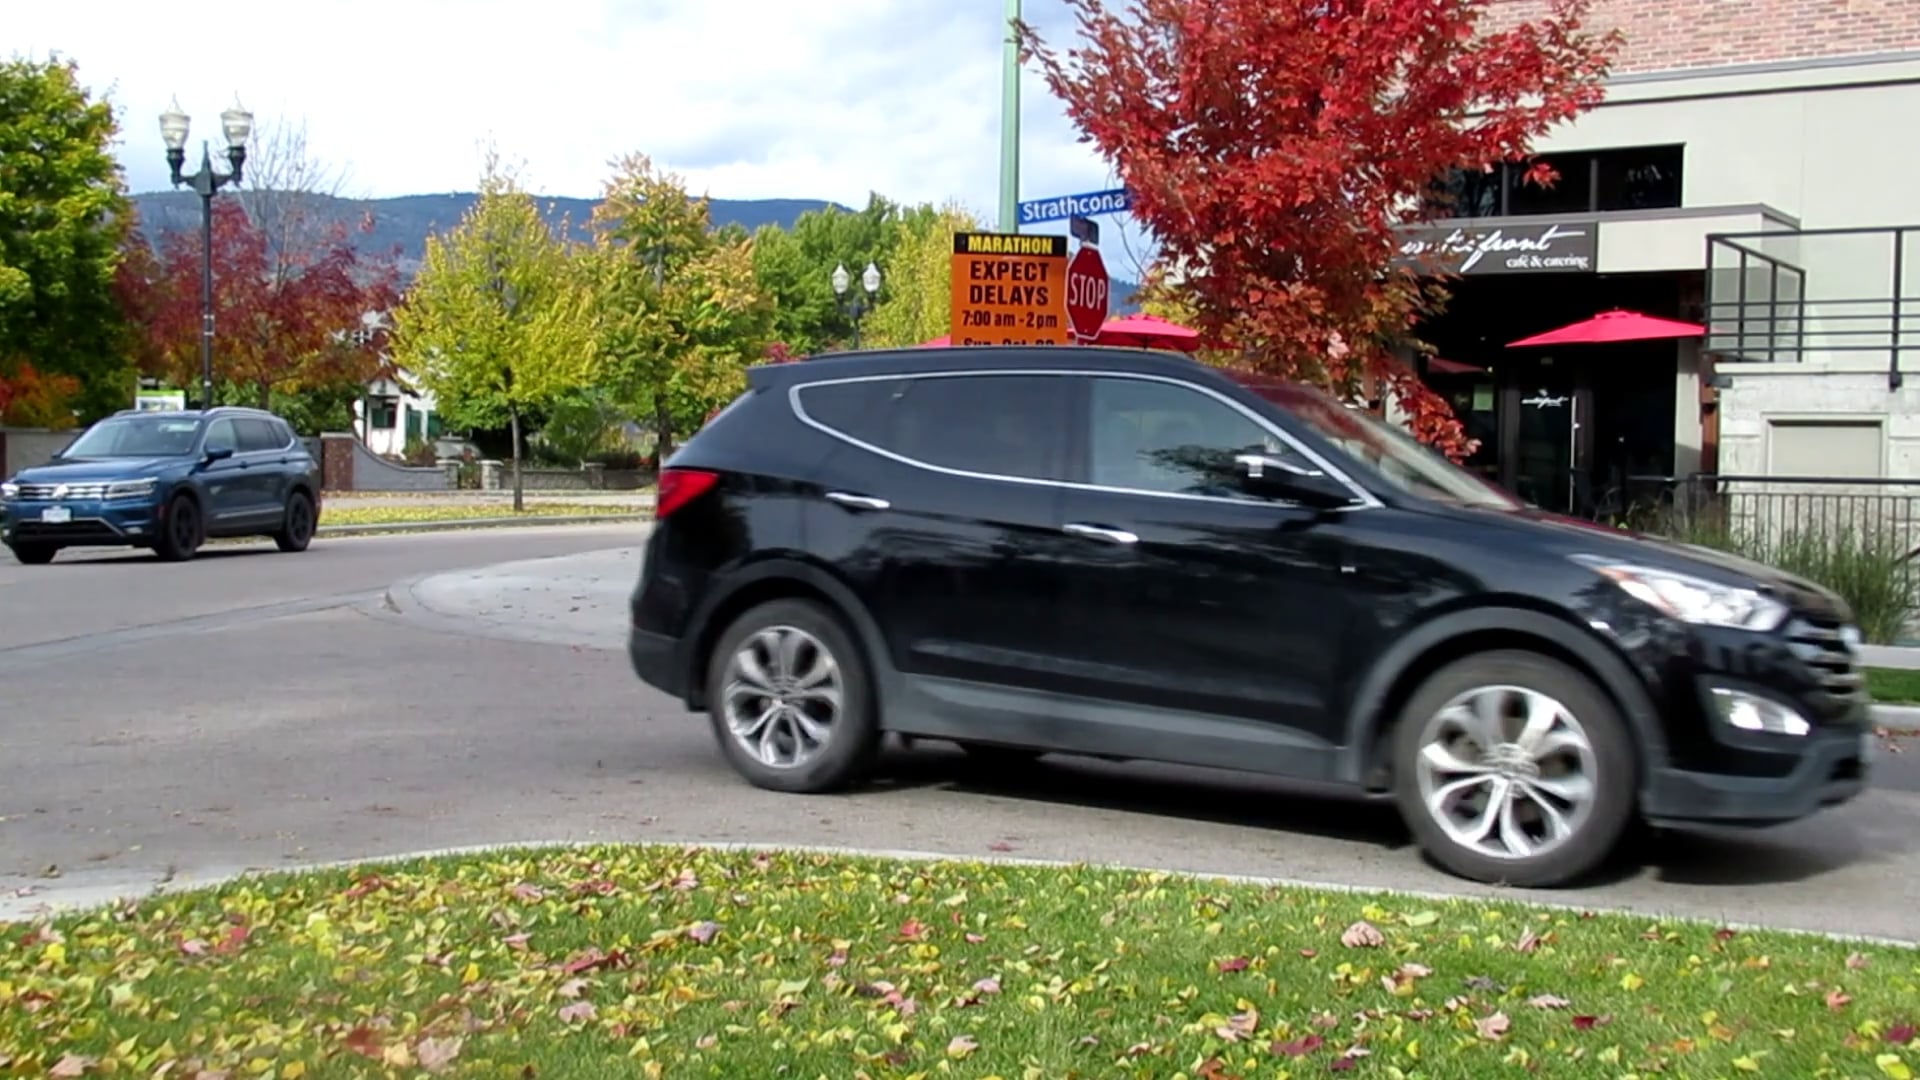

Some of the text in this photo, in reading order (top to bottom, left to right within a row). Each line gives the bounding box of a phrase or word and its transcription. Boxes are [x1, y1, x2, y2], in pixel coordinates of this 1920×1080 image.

[1022, 194, 1125, 221] Strathcona
[968, 235, 1053, 254] MARATHON
[970, 261, 1049, 282] EXPECT
[1530, 255, 1542, 268] &
[970, 285, 1049, 306] DELAYS
[1069, 273, 1105, 310] STOP
[962, 310, 991, 326] 7:00
[994, 313, 1015, 327] am
